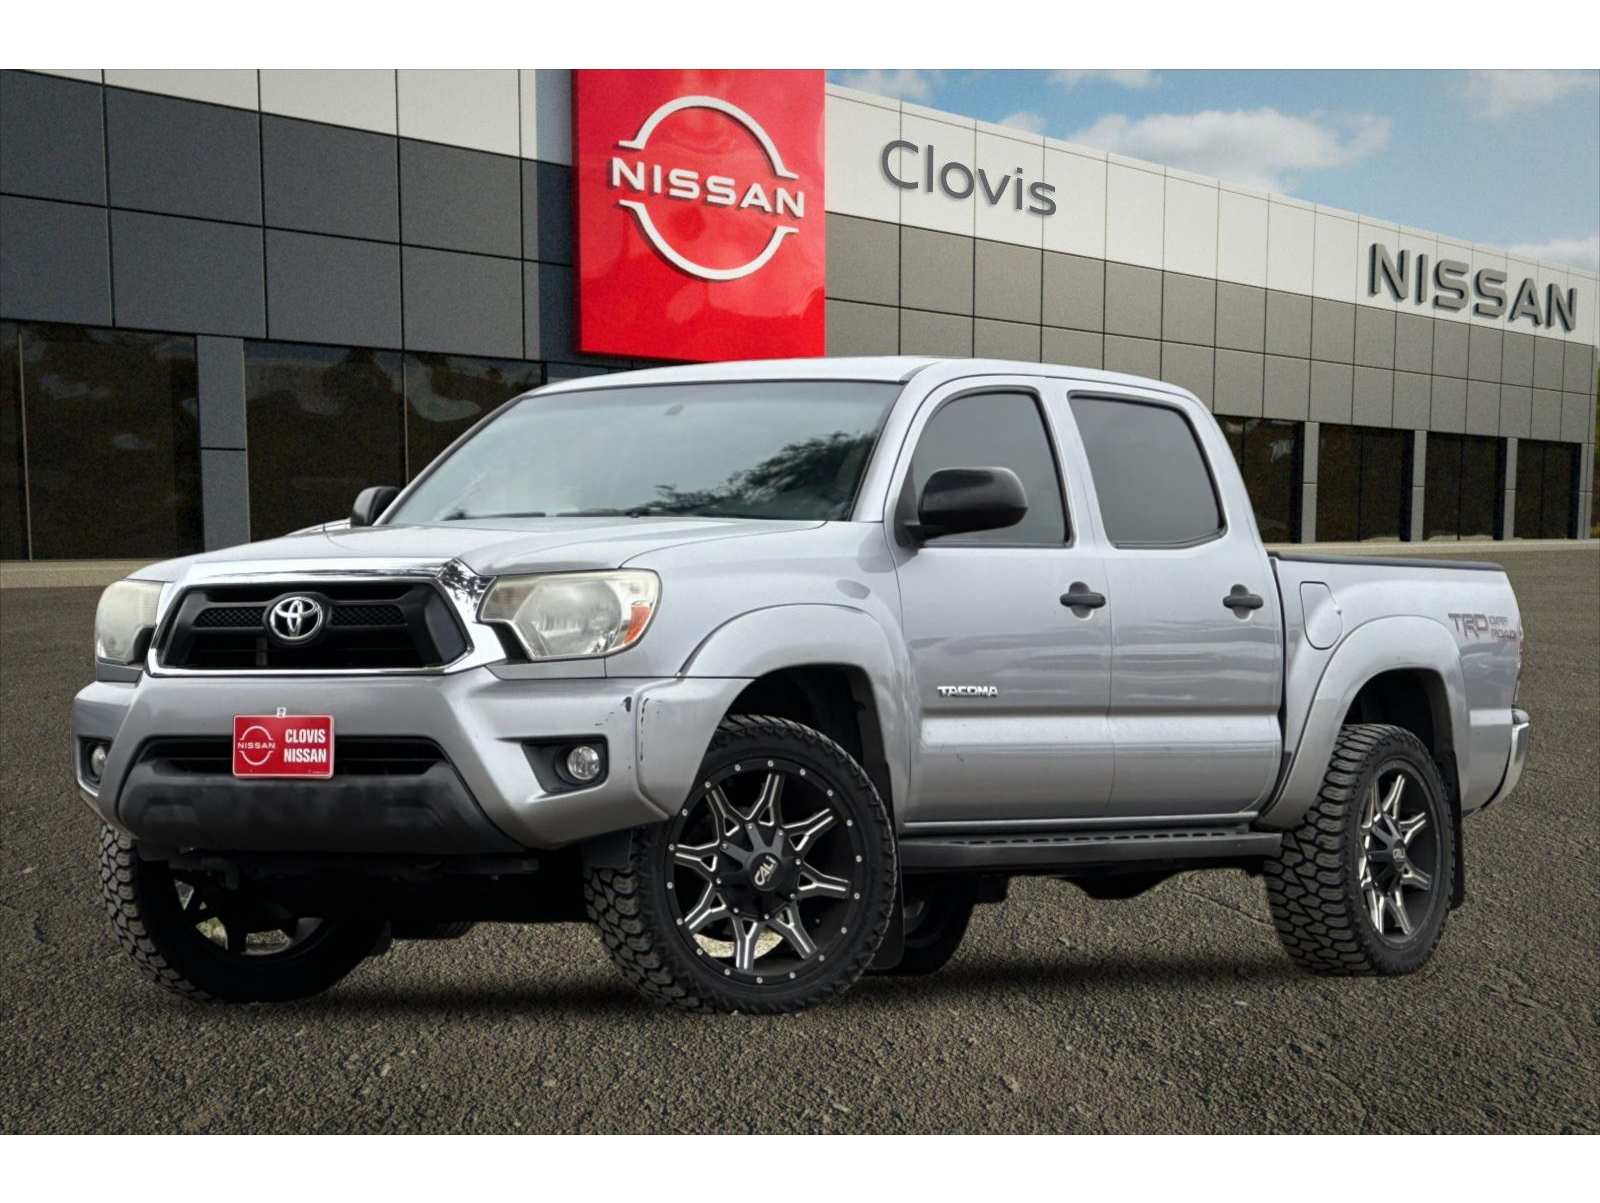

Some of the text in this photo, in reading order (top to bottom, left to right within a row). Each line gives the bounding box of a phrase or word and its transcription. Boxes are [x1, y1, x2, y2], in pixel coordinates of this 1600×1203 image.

[611, 156, 805, 218] NISSAN
[881, 139, 1057, 217] Clovis
[1368, 242, 1578, 332] NISSAN
[1447, 612, 1489, 640] TRD
[937, 685, 998, 698] TACOMA
[237, 741, 276, 750] NISSAN
[284, 728, 326, 744] CLOVIS
[283, 748, 327, 763] NISSAN
